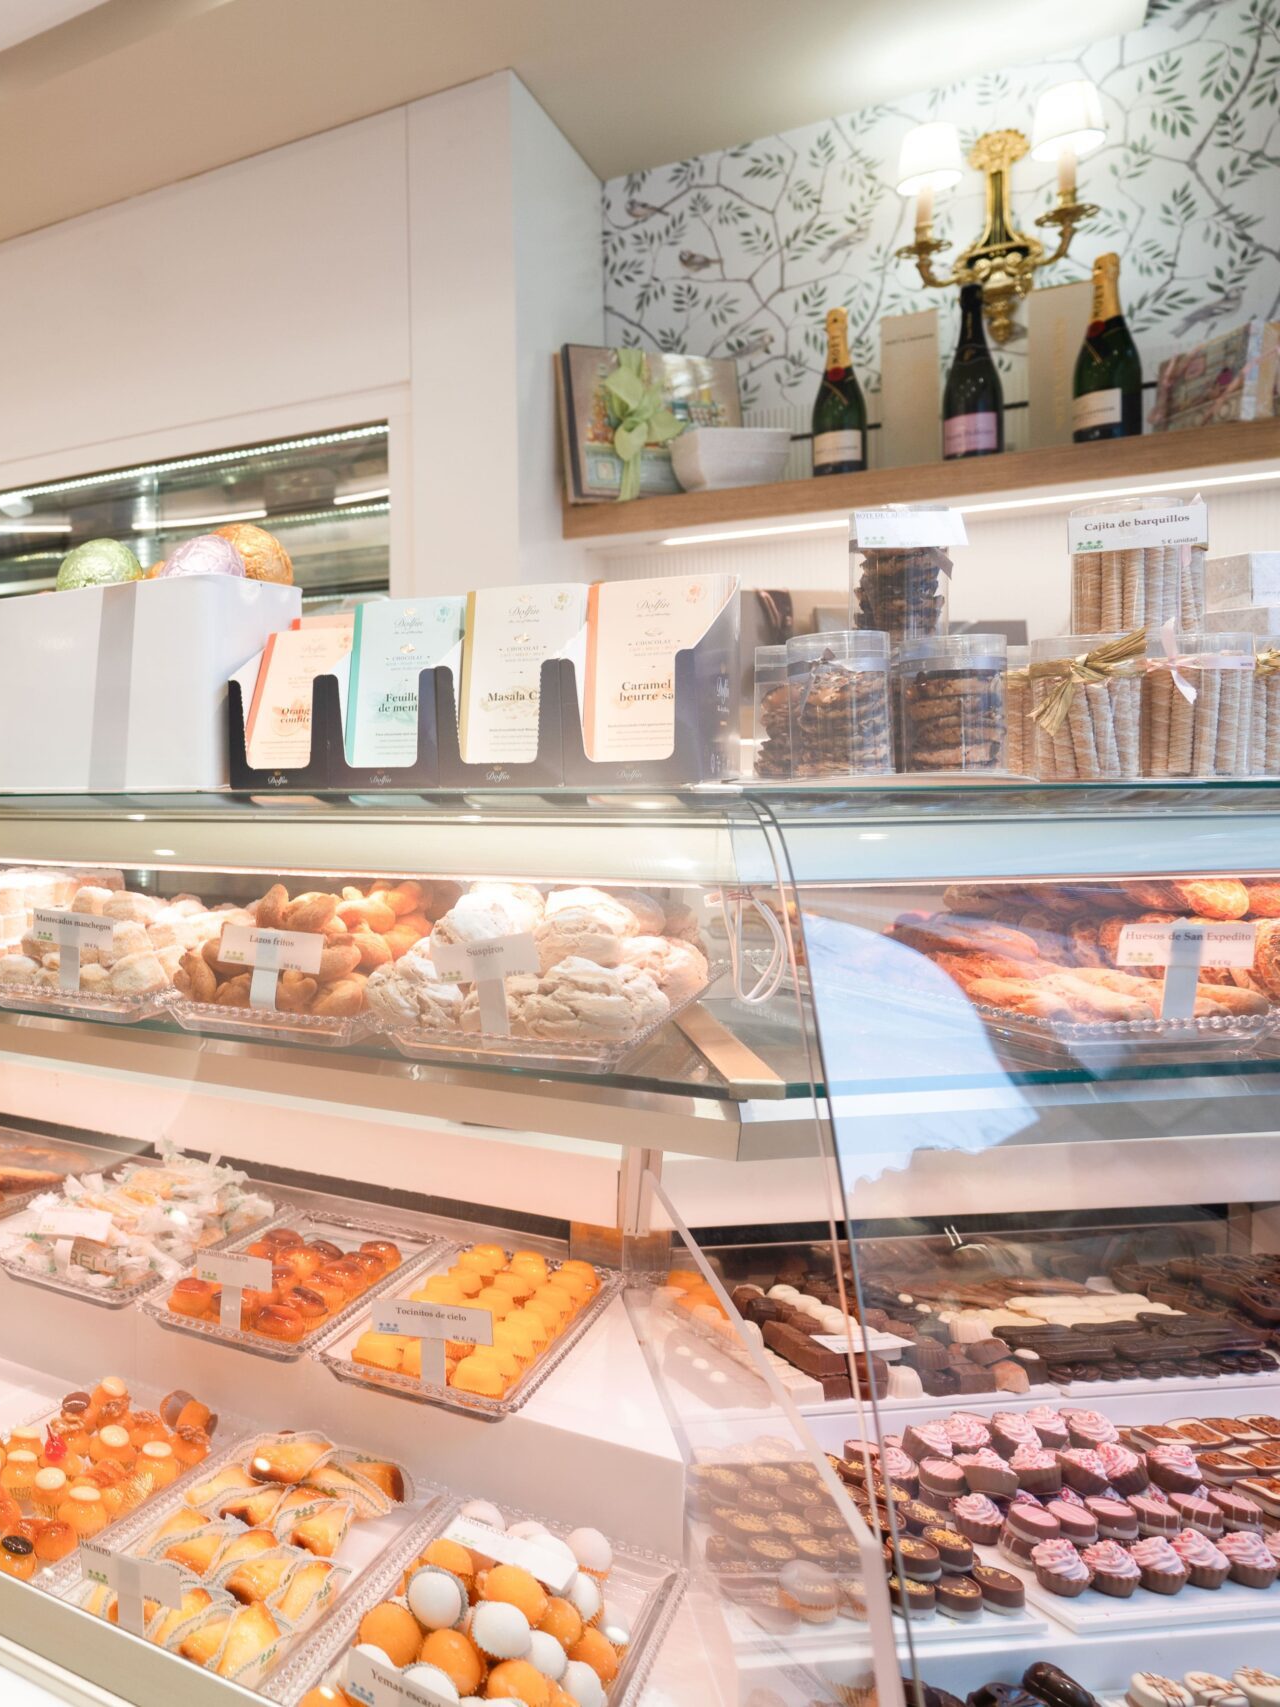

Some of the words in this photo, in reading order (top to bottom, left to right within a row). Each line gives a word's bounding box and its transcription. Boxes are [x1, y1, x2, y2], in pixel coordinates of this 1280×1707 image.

[1084, 522, 1116, 532] Cajita
[1118, 519, 1131, 528] de
[1134, 514, 1190, 527] barquillos
[622, 680, 671, 691] Caramel
[488, 691, 525, 702] Masala
[620, 692, 658, 702] beurre
[662, 692, 674, 700] sa
[378, 704, 390, 712] de
[36, 914, 73, 926] Mantecados
[74, 920, 111, 932] manchegos
[250, 935, 271, 944] Lazos
[273, 936, 294, 947] fritos
[1126, 931, 1165, 940] Huesos
[1168, 931, 1182, 940] de
[1184, 931, 1204, 940] San
[1207, 931, 1251, 942] Expedito
[466, 945, 504, 957] Suspiros
[396, 1307, 433, 1318] Tocinitos
[435, 1311, 445, 1319] de
[447, 1313, 467, 1321] cielo
[371, 1668, 404, 1694] Yemas
